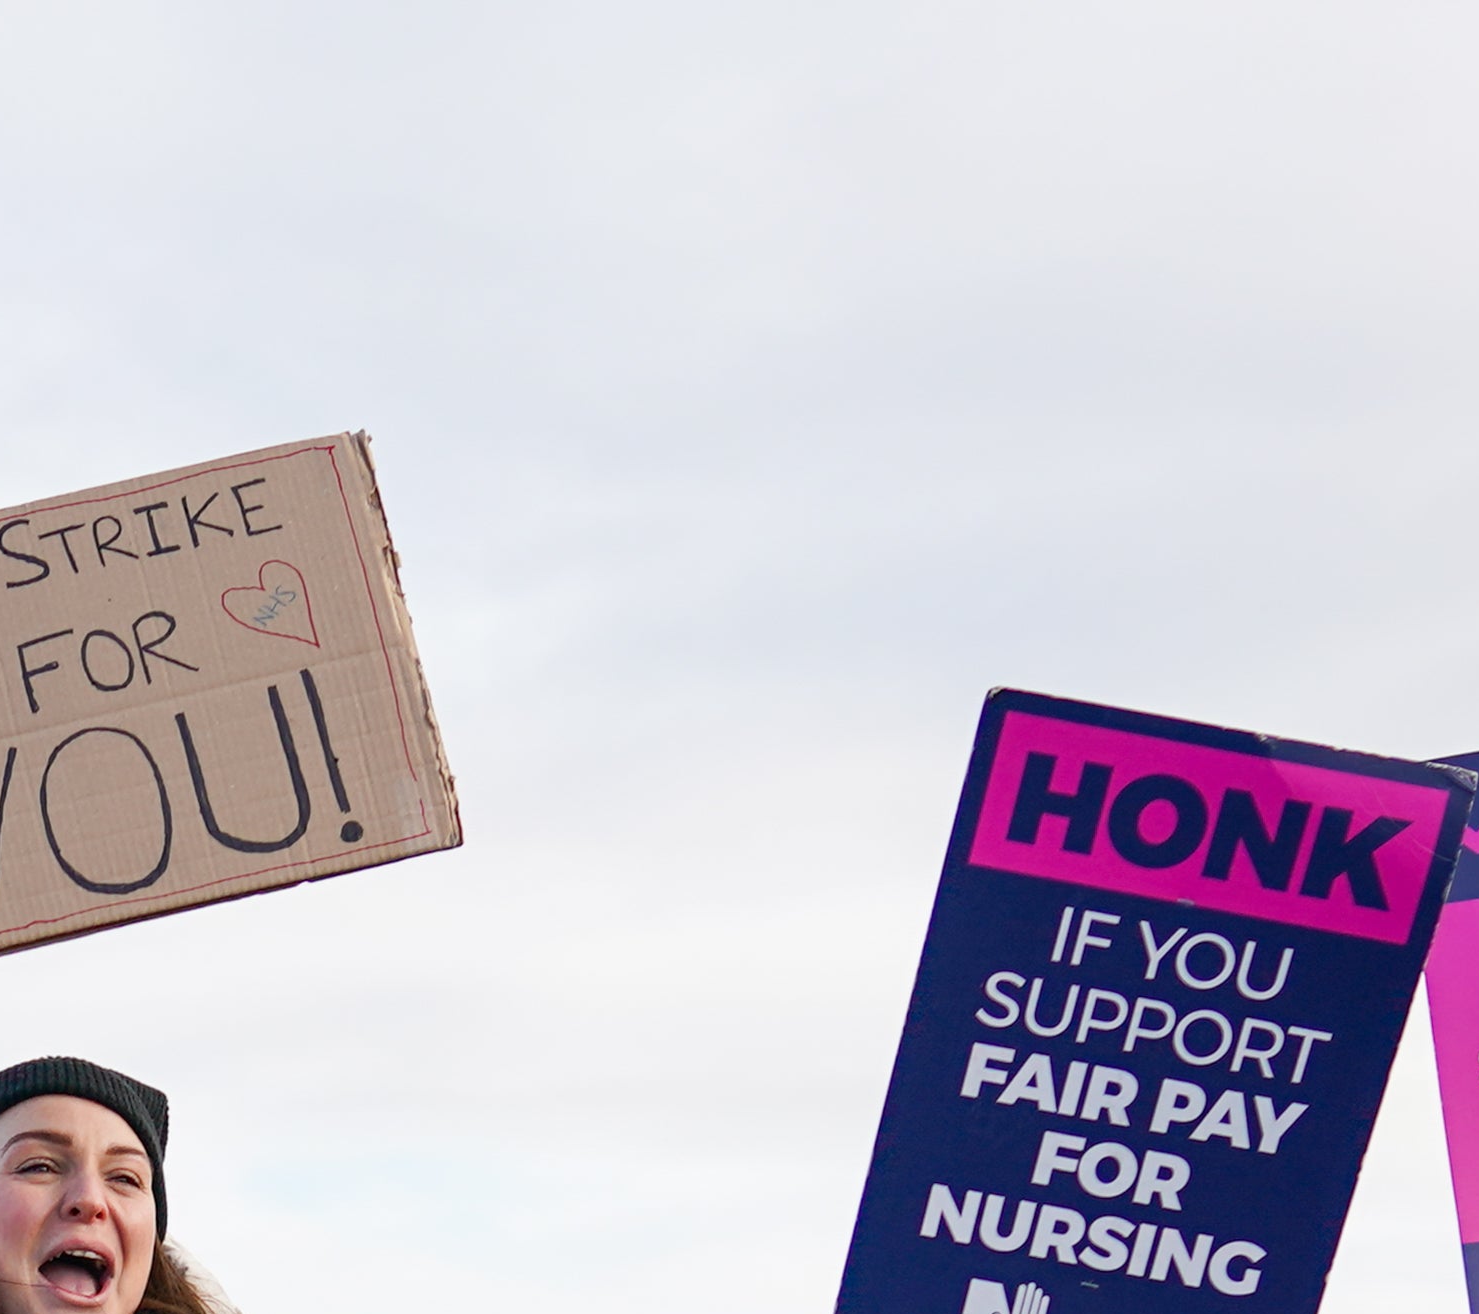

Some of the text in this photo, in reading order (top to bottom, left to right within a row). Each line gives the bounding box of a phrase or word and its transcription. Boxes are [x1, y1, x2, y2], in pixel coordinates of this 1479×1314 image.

[251, 585, 297, 629] NHS
[17, 611, 199, 713] FOR
[1006, 752, 1414, 912] HONK
[1051, 906, 1294, 1000] IF YOU
[976, 971, 1332, 1084] SUPPORT
[961, 1042, 1308, 1155] FAIR PAY
[1031, 1130, 1192, 1211] FOR
[920, 1183, 1267, 1297] NURSING
